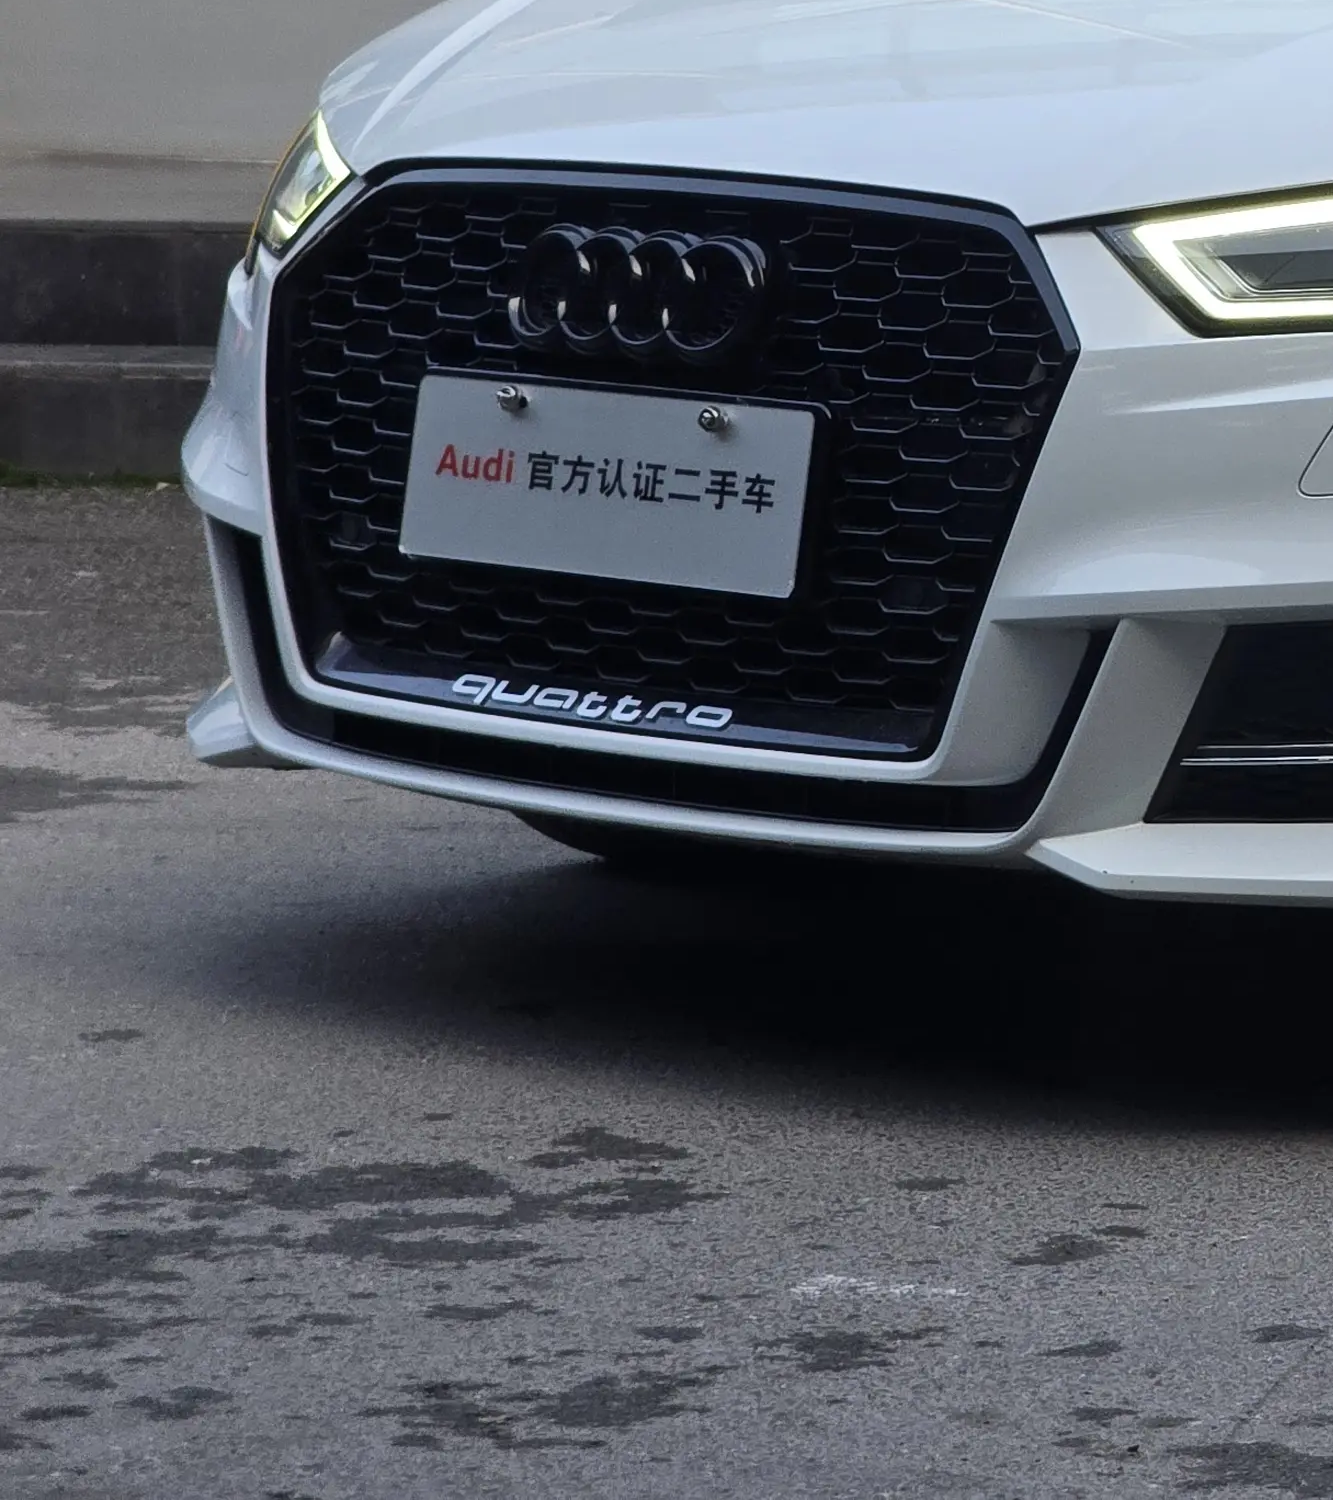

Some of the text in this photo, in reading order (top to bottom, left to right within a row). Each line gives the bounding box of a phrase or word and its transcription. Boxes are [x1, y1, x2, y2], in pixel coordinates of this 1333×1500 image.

[435, 443, 776, 514] Audi 官方认证二手车
[452, 673, 733, 730] quattro
